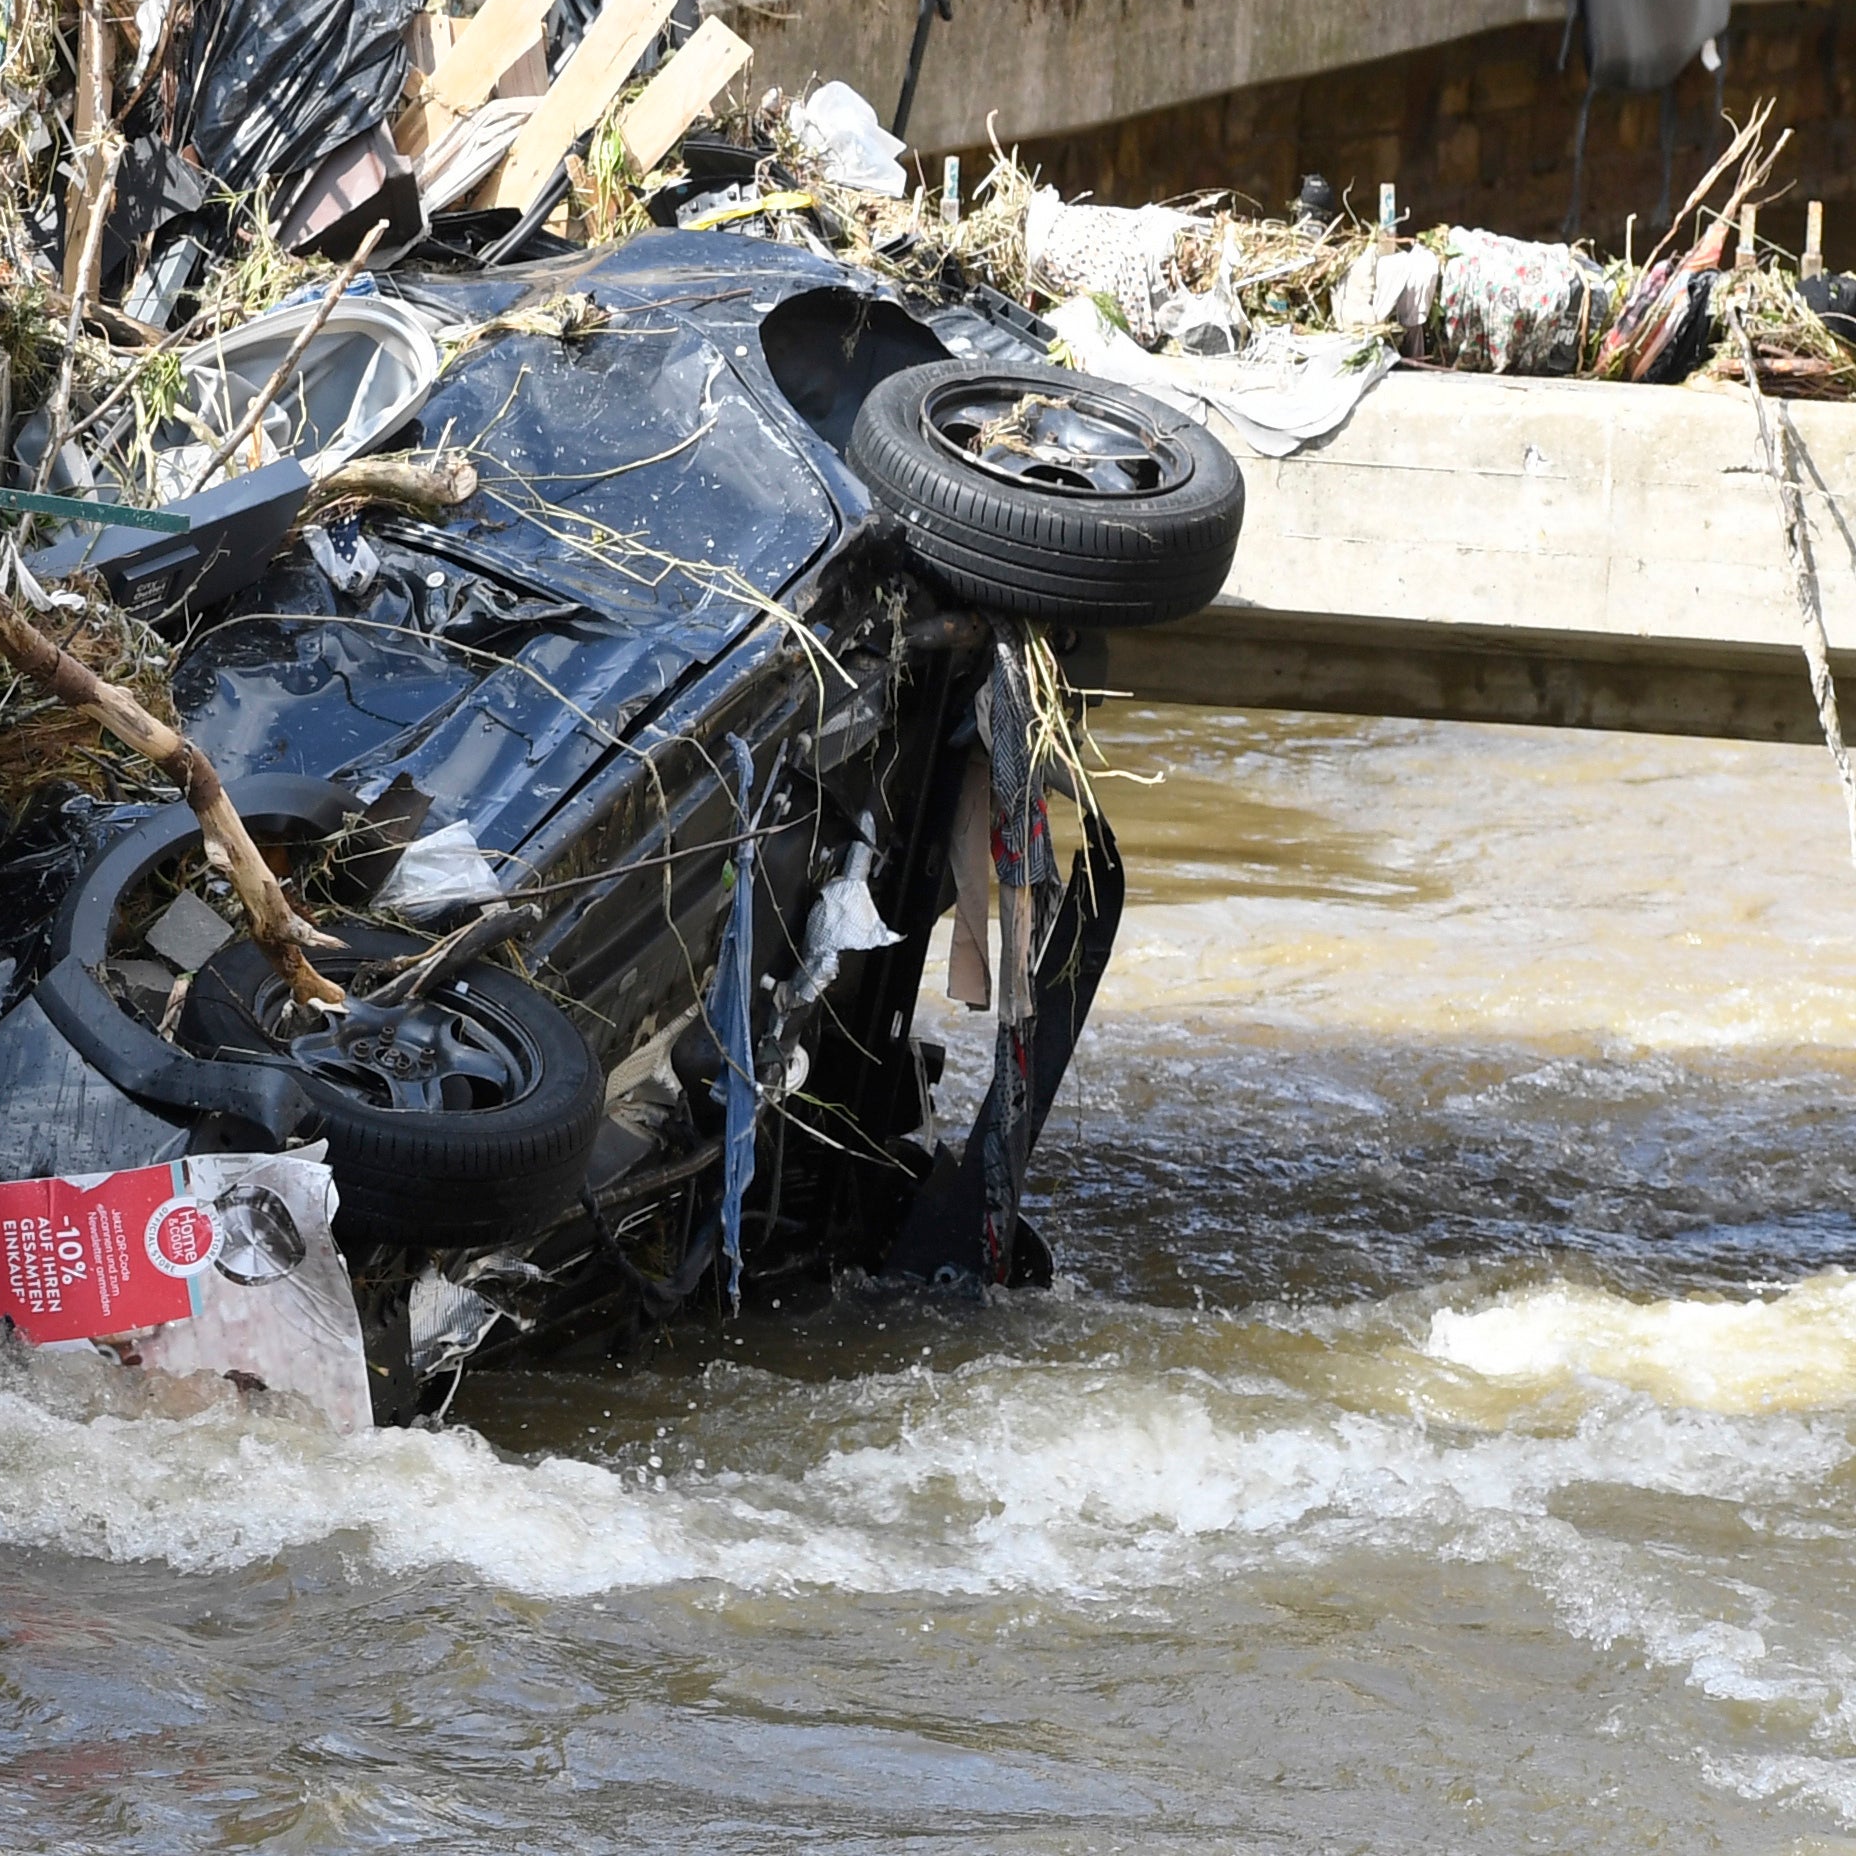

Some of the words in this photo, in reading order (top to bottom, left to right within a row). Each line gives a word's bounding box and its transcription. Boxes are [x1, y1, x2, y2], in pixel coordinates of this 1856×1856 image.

[38, 1216, 55, 1252] AUF
[112, 1209, 125, 1235] Jetzt
[147, 1207, 169, 1246] OFFICIAL
[168, 1218, 185, 1261] &COOK
[179, 1210, 198, 1262] Home
[20, 1218, 45, 1313] GESAMTEN
[56, 1215, 88, 1285] -10%
[88, 1211, 103, 1265] Newsletter
[96, 1265, 112, 1317] anmelden
[107, 1254, 118, 1276] und
[116, 1236, 130, 1282] QR-Code
[151, 1249, 176, 1274] STORE
[42, 1256, 63, 1313] IHREN
[110, 1275, 121, 1296] zum
